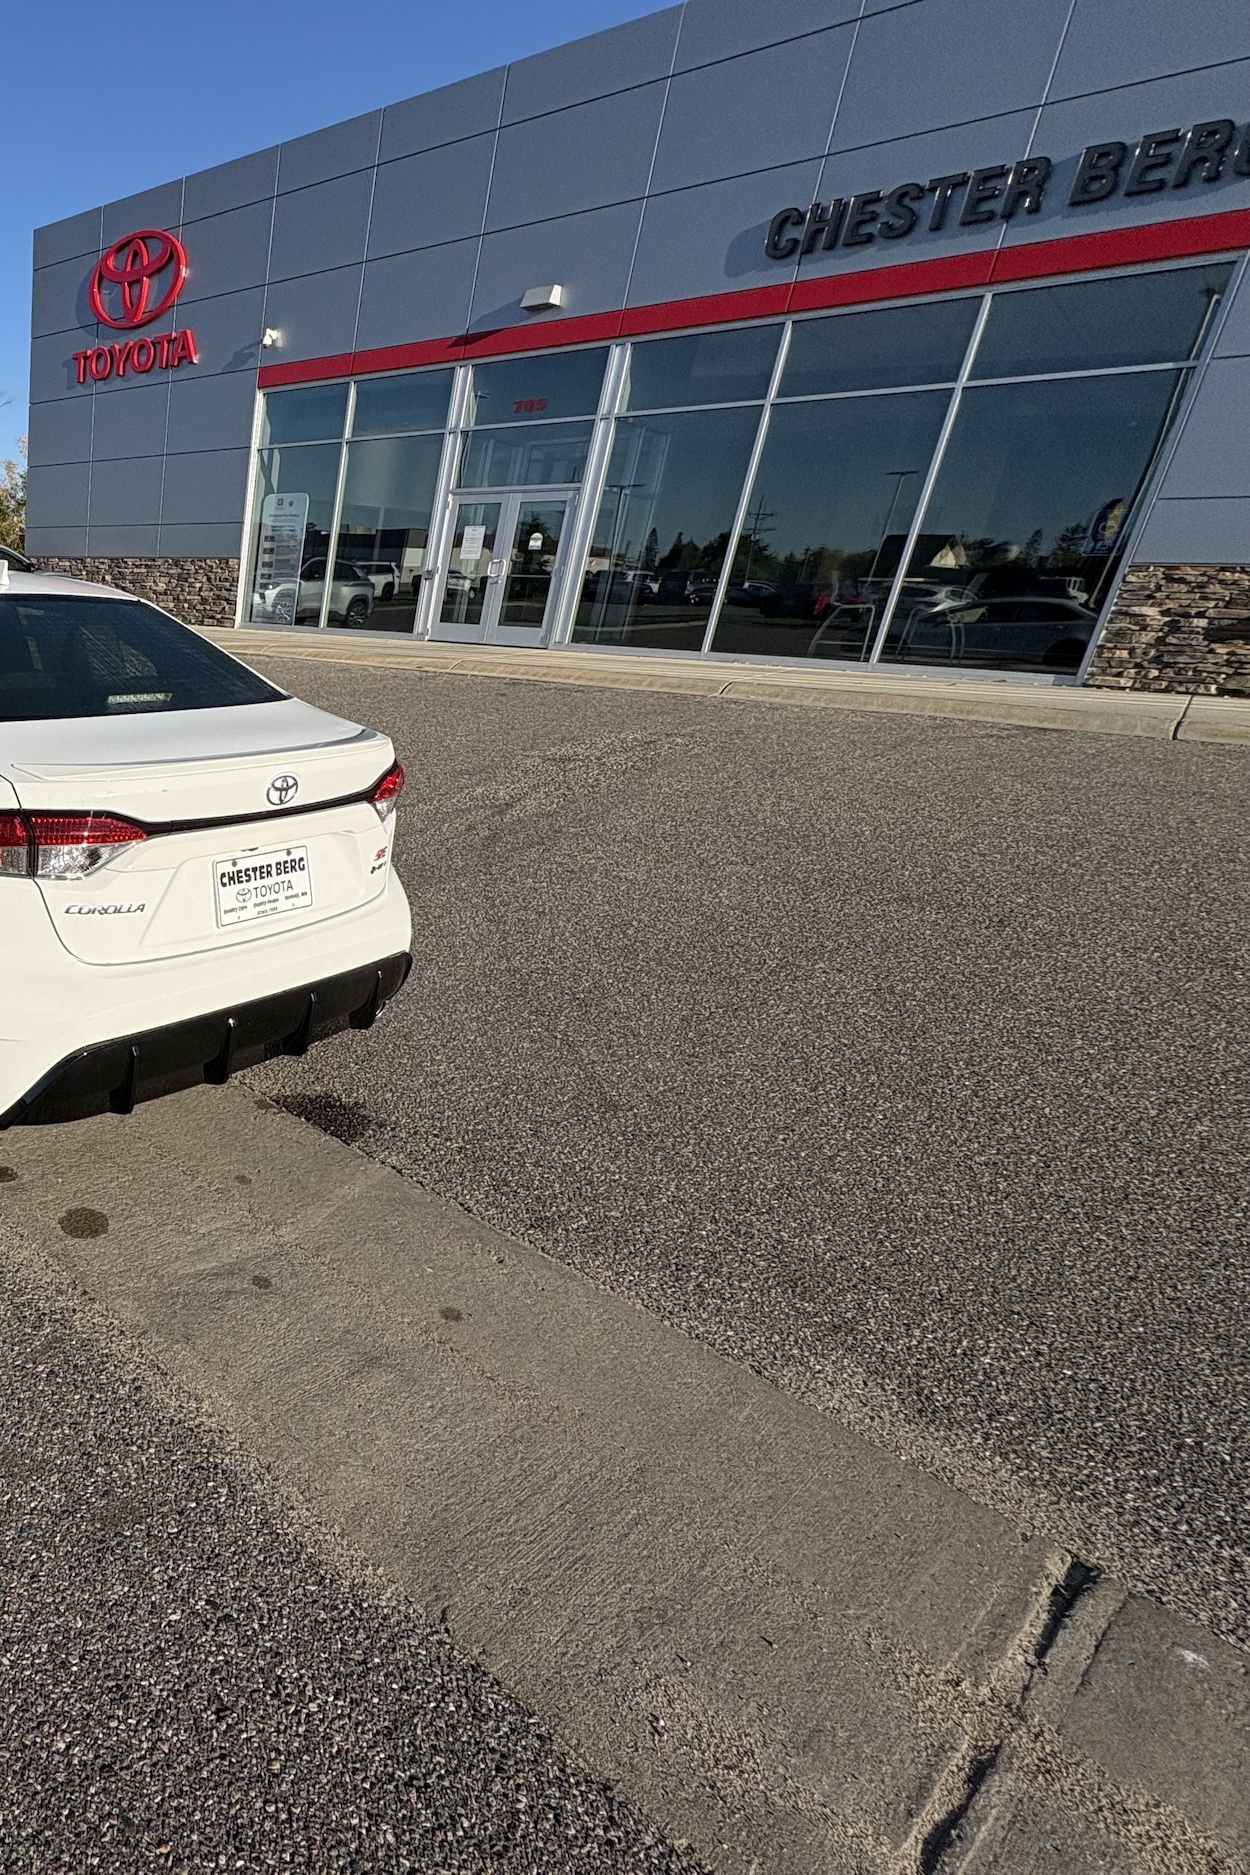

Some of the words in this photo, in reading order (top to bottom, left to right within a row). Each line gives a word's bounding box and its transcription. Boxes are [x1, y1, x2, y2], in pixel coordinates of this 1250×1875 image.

[764, 157, 1051, 260] CHESTER
[72, 329, 197, 384] TOYOTA
[220, 863, 273, 888] CHESTER
[275, 856, 306, 877] BERG
[253, 879, 294, 899] TOYOTA
[64, 903, 146, 915] COROLLA
